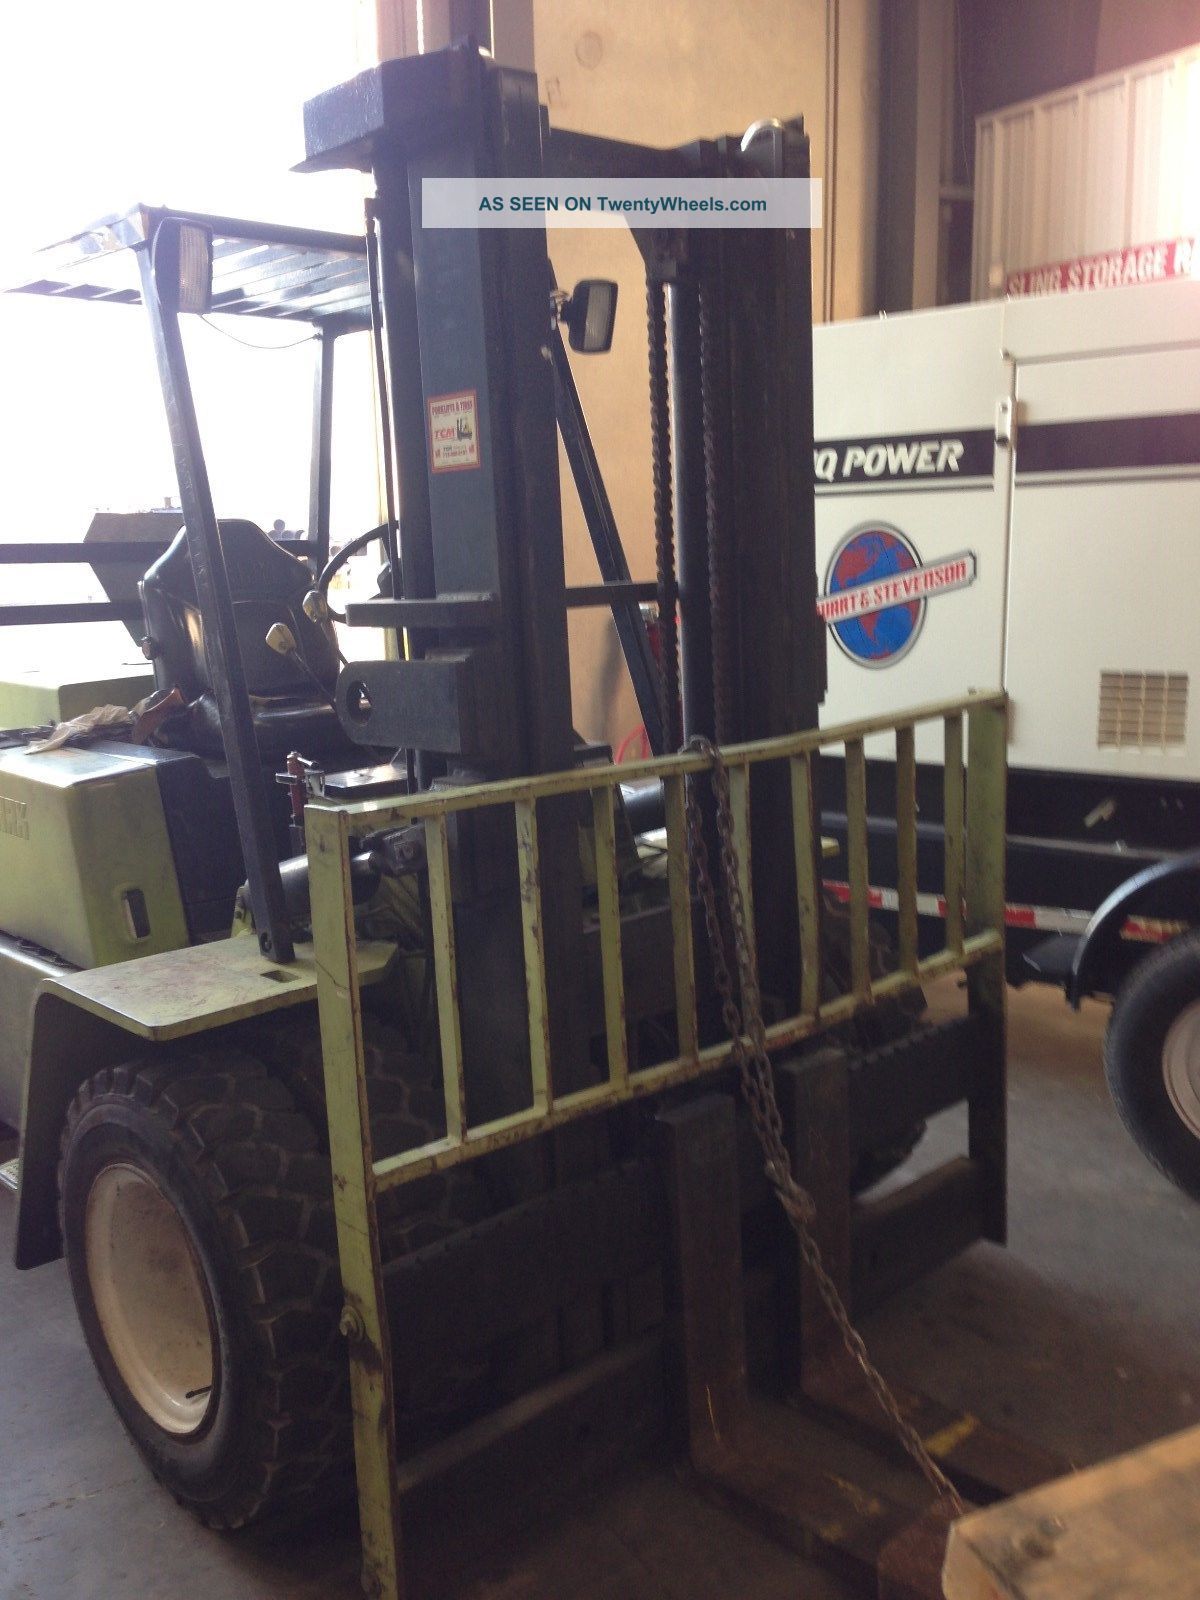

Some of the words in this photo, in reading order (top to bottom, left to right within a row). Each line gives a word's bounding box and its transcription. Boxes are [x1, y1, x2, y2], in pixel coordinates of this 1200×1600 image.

[1006, 266, 1061, 296] SLING
[1067, 246, 1167, 291] STORAGE
[814, 447, 838, 482] Q
[842, 439, 964, 477] POWER
[860, 587, 870, 608] &
[873, 560, 968, 606] STEVENSON
